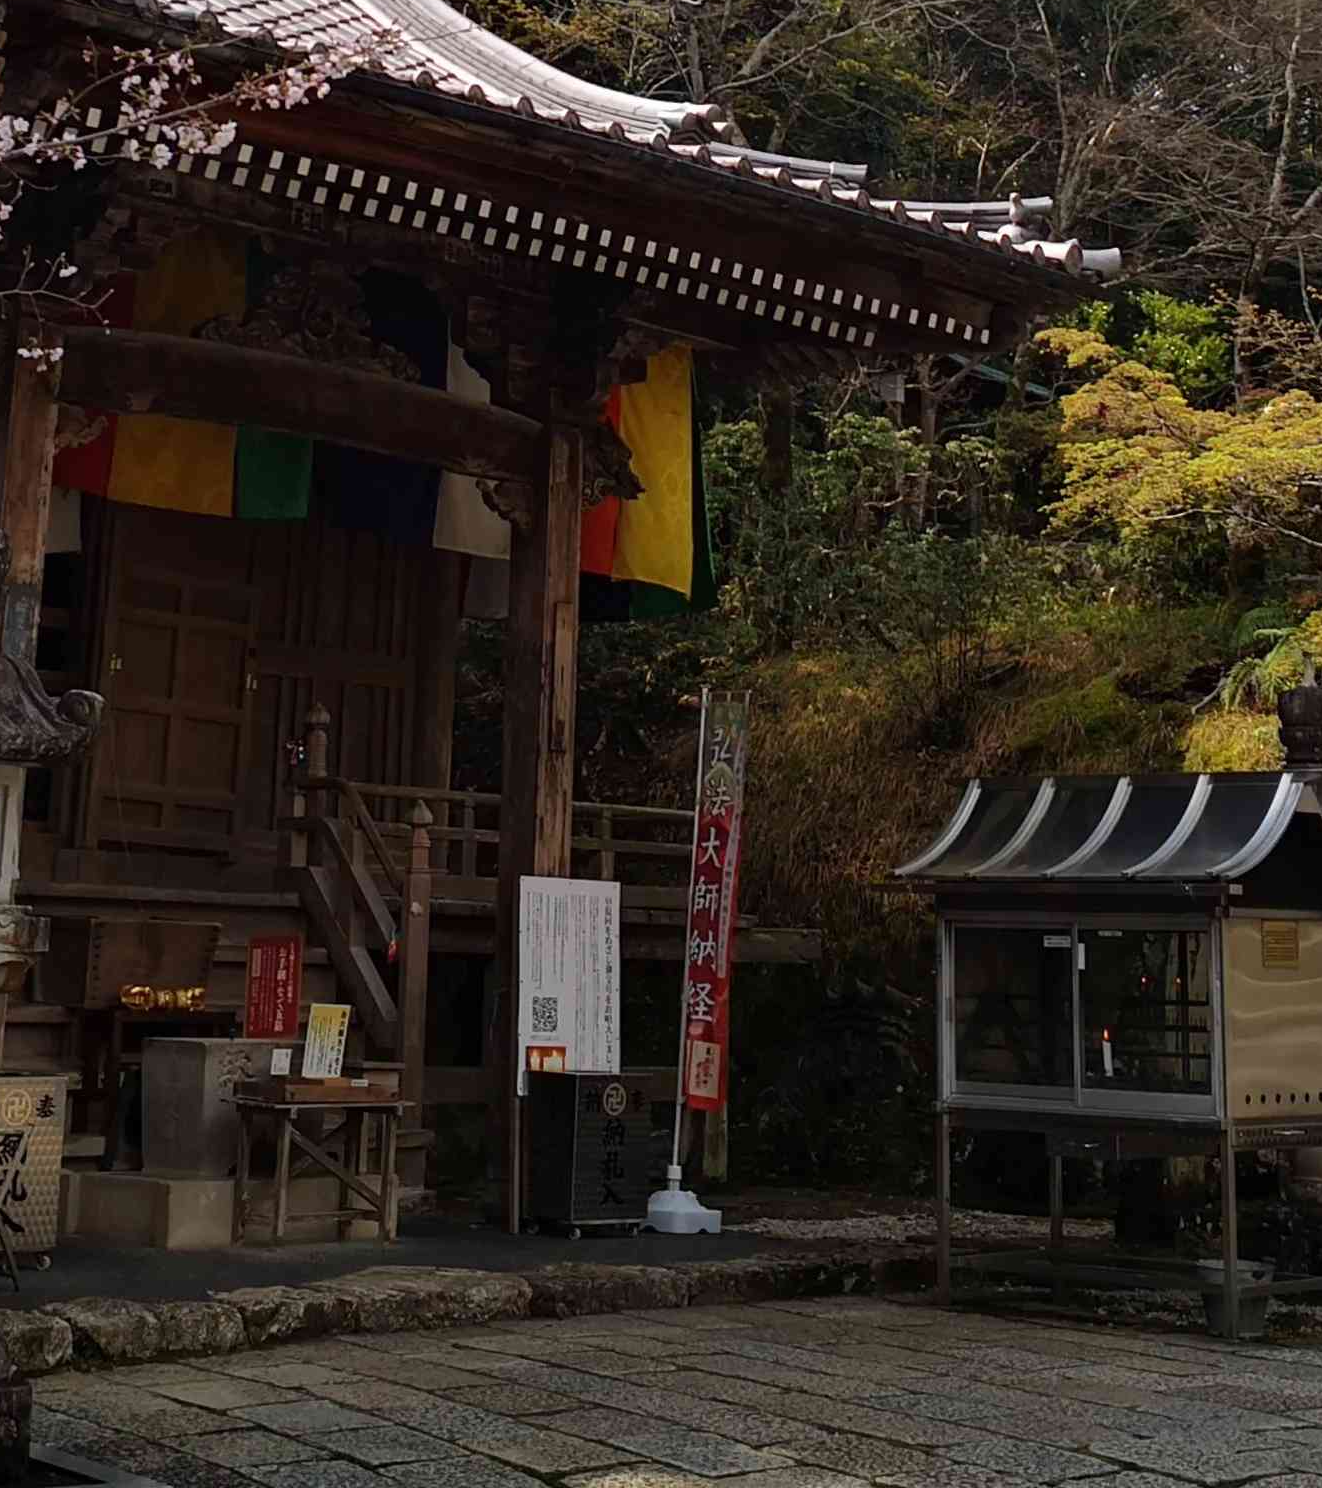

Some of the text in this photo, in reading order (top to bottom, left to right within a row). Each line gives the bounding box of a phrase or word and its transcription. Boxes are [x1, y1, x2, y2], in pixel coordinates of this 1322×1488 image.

[683, 726, 731, 1025] 弘法大師納経
